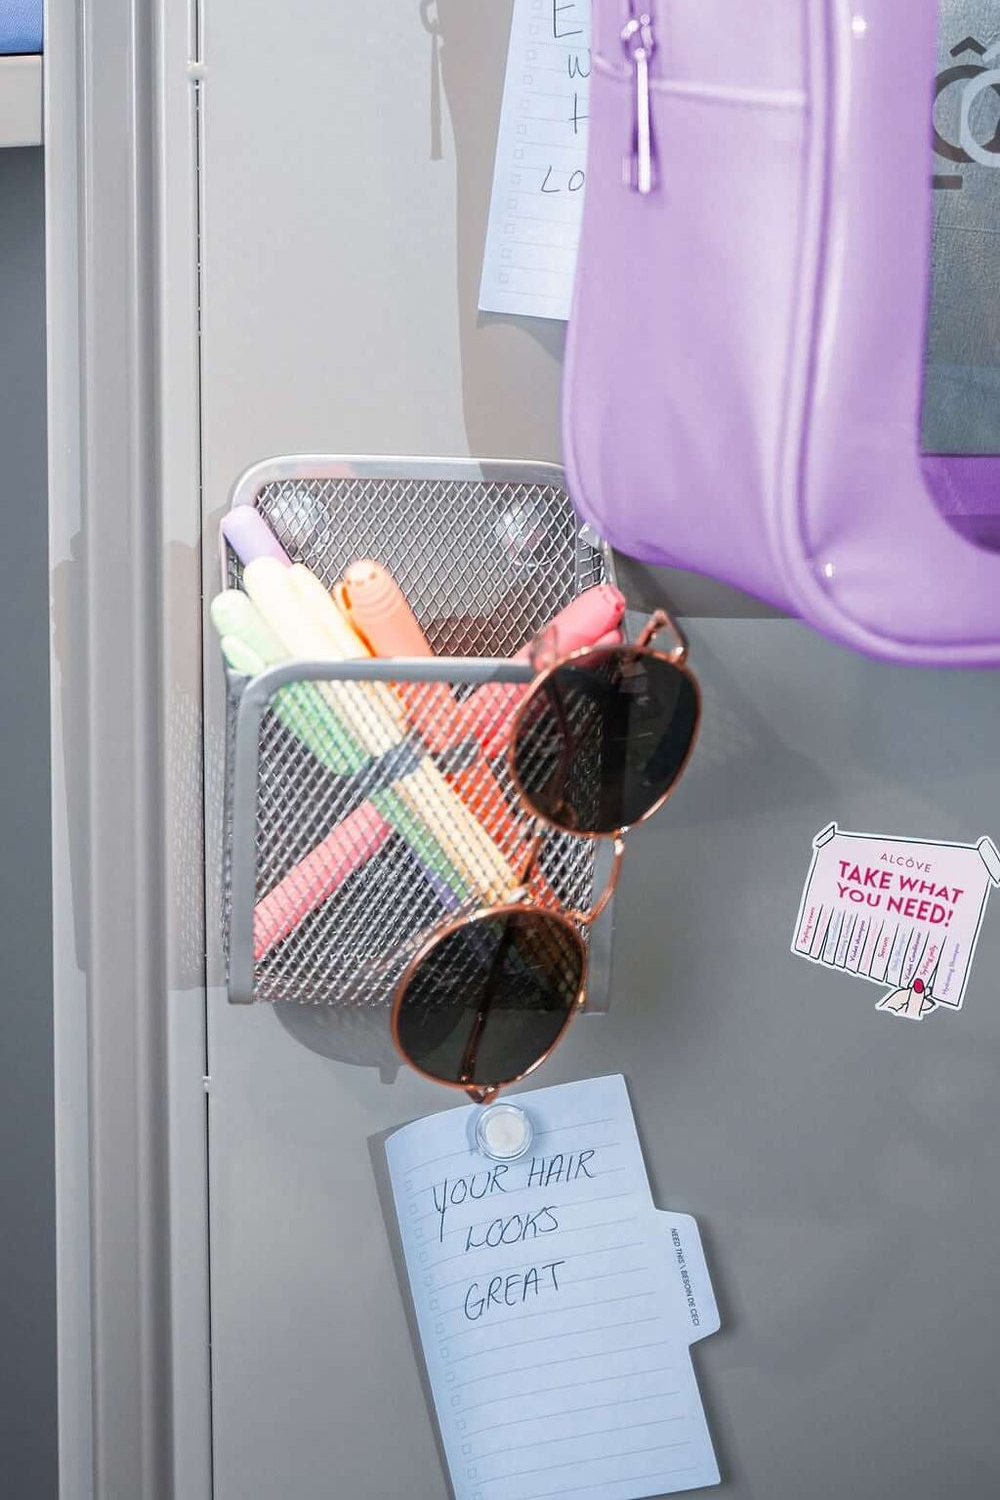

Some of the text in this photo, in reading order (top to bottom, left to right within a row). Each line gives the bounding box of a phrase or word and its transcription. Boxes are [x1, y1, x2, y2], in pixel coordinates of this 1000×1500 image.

[839, 860, 964, 904] TAKE WHAT
[837, 882, 954, 928] YOU NEED!
[877, 936, 889, 958] Serum
[433, 1150, 595, 1243] YOUR HAIR
[465, 1205, 559, 1252] LOOKS
[670, 1227, 681, 1247] NEED
[675, 1248, 685, 1264] THIS
[464, 1261, 565, 1321] GREAT
[681, 1269, 693, 1297] BESOIN
[687, 1298, 696, 1307] DE
